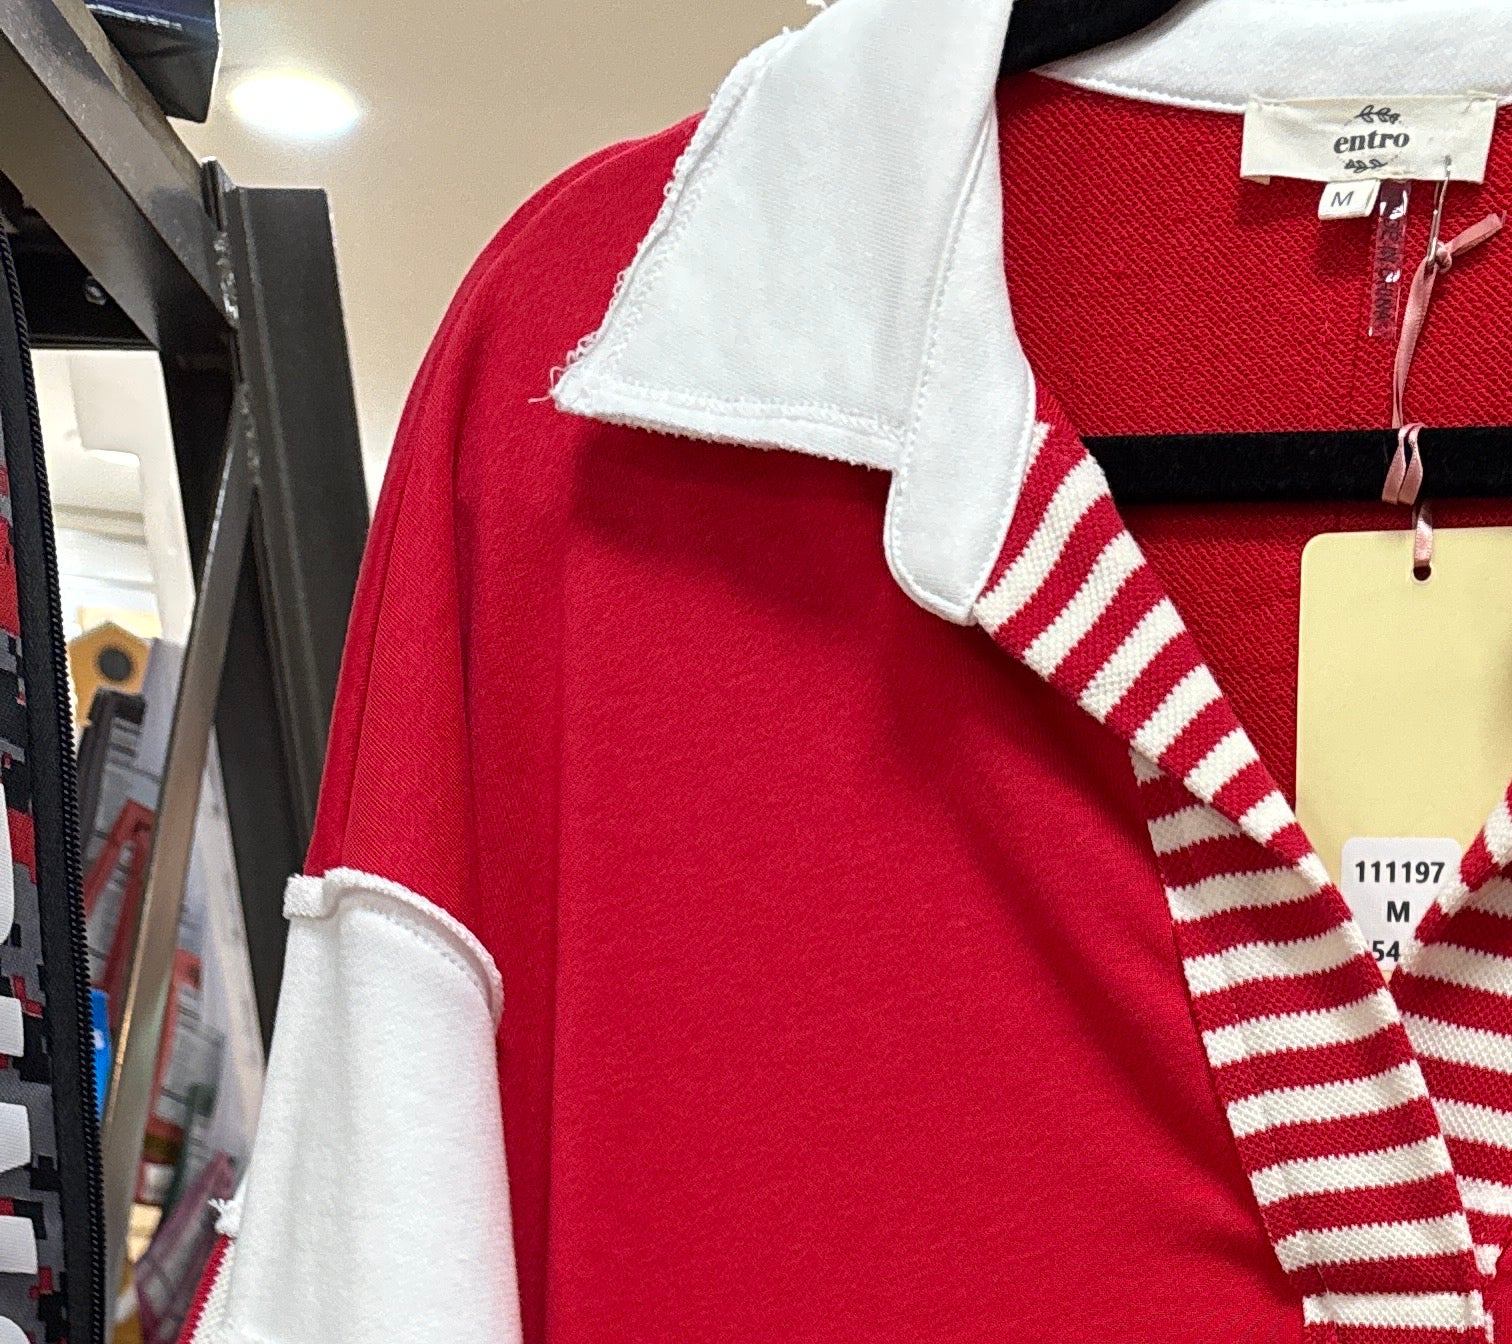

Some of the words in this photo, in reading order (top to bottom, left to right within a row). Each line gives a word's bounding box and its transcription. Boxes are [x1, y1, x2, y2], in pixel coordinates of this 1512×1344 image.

[1333, 130, 1410, 154] entro
[1331, 191, 1354, 208] M
[1355, 860, 1446, 884] 111197
[1387, 900, 1410, 923] M
